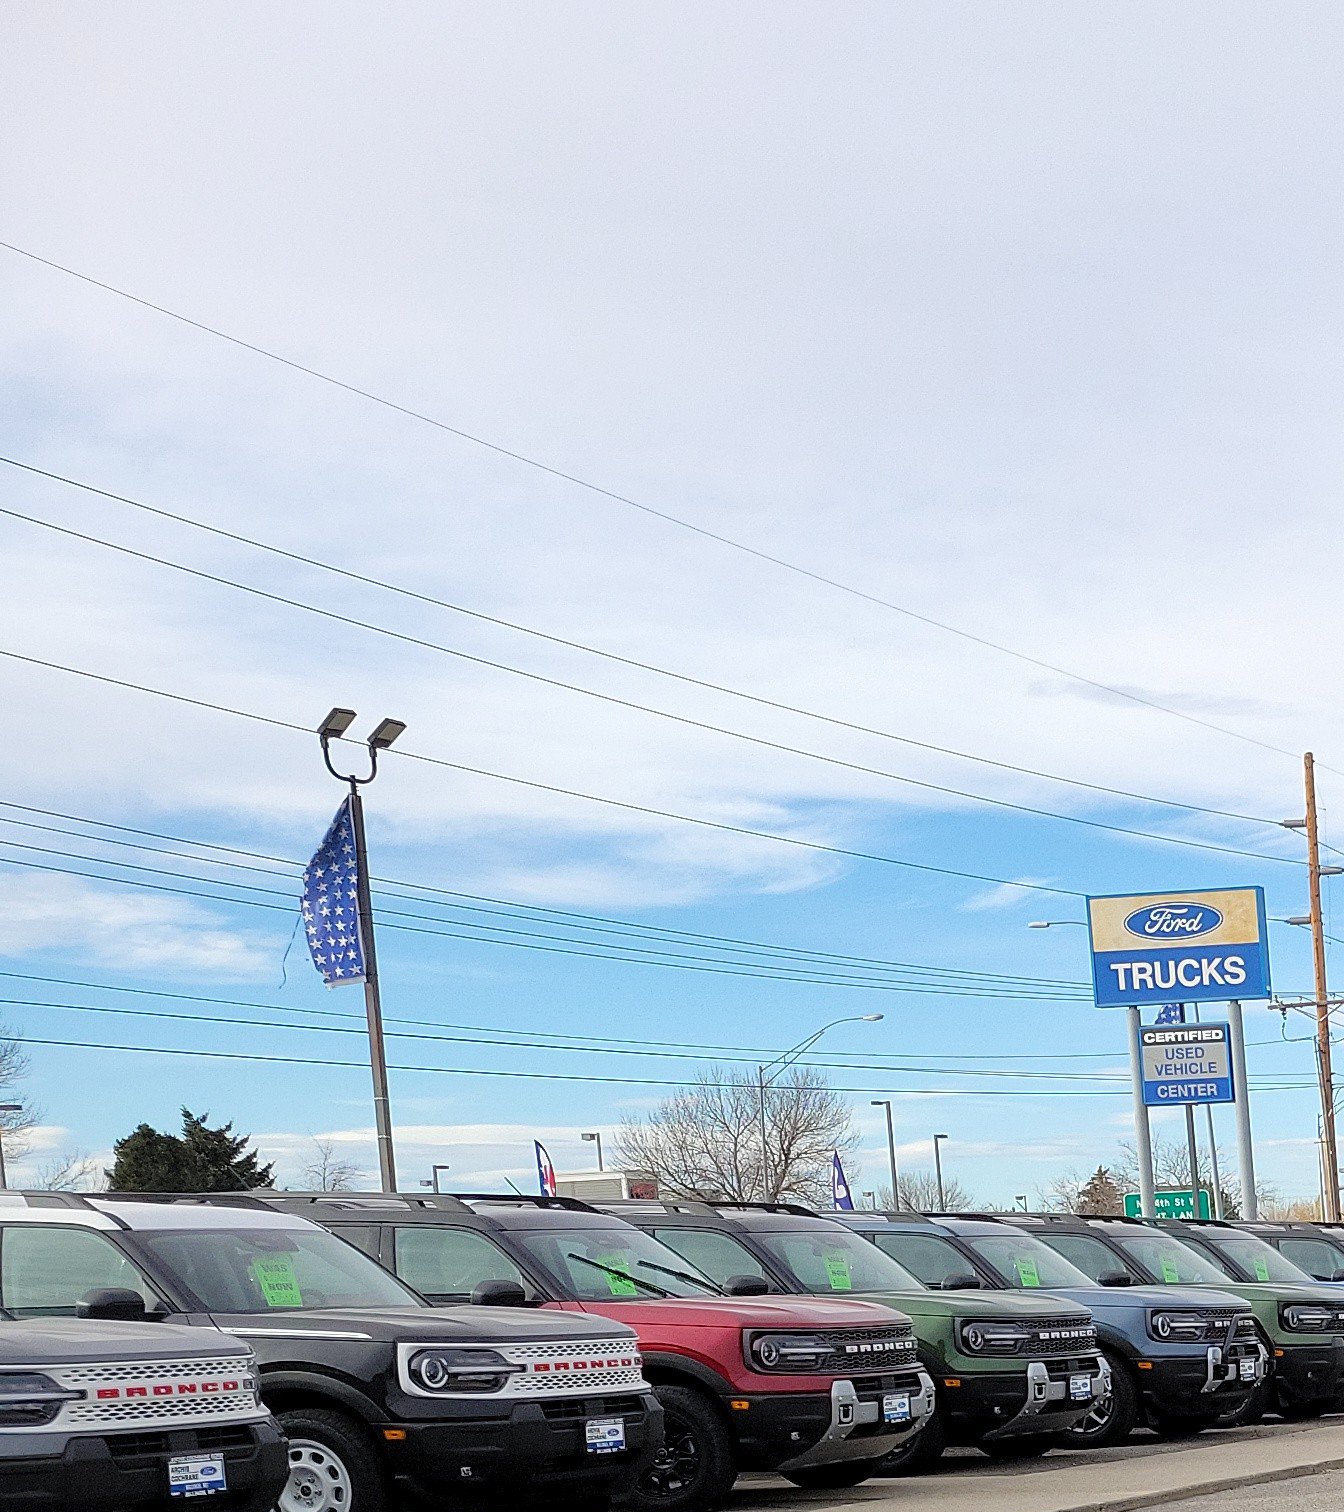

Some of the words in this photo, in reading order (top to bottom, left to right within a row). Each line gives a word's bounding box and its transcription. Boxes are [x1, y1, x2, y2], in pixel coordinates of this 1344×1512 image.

[1144, 908, 1203, 934] Ford
[1110, 956, 1246, 991] TRUCKS
[1143, 1029, 1223, 1044] CERTIFIED
[1165, 1047, 1205, 1060] USED
[1154, 1061, 1218, 1076] VEHICLE
[1156, 1083, 1218, 1098] CENTER
[1174, 1198, 1185, 1206] St
[1039, 1329, 1093, 1340] BRONCO
[845, 1341, 913, 1353] BRONCO
[533, 1359, 632, 1372] BRONCO
[96, 1380, 239, 1399] BRONCO
